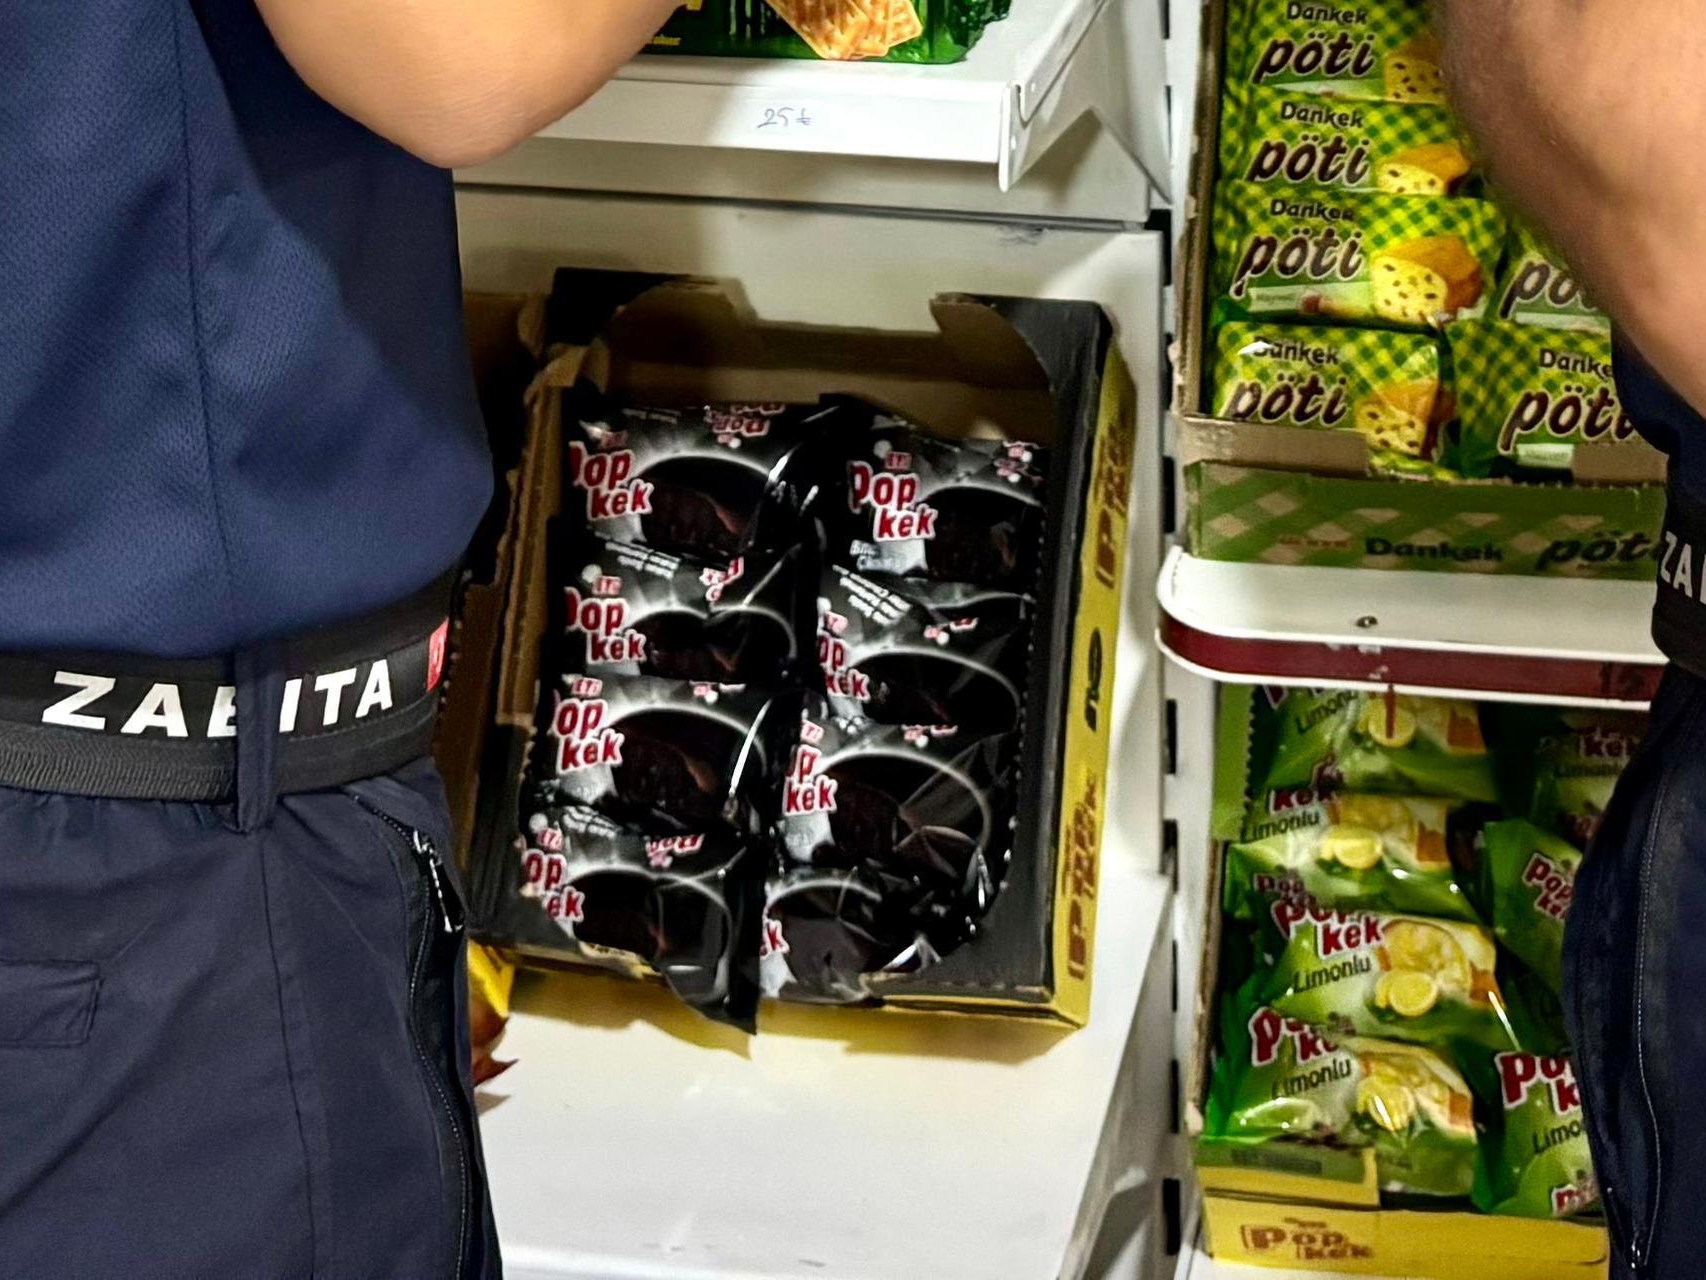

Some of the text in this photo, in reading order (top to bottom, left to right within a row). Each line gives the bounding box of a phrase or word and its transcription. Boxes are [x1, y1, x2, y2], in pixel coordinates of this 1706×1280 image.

[1286, 0, 1368, 26] Dankek
[1252, 29, 1376, 85] pöti
[1278, 100, 1366, 129] Dankek
[1247, 133, 1374, 187] pöti
[1230, 228, 1367, 299] pöti
[1538, 347, 1613, 379] Danke
[1220, 373, 1350, 427] pöti
[587, 478, 654, 520] kek
[873, 502, 938, 541] kek
[586, 629, 647, 664] kek
[554, 697, 608, 739] op
[557, 728, 624, 774] kek
[782, 775, 838, 817] kek
[523, 849, 566, 887] op
[1320, 910, 1385, 959] kek
